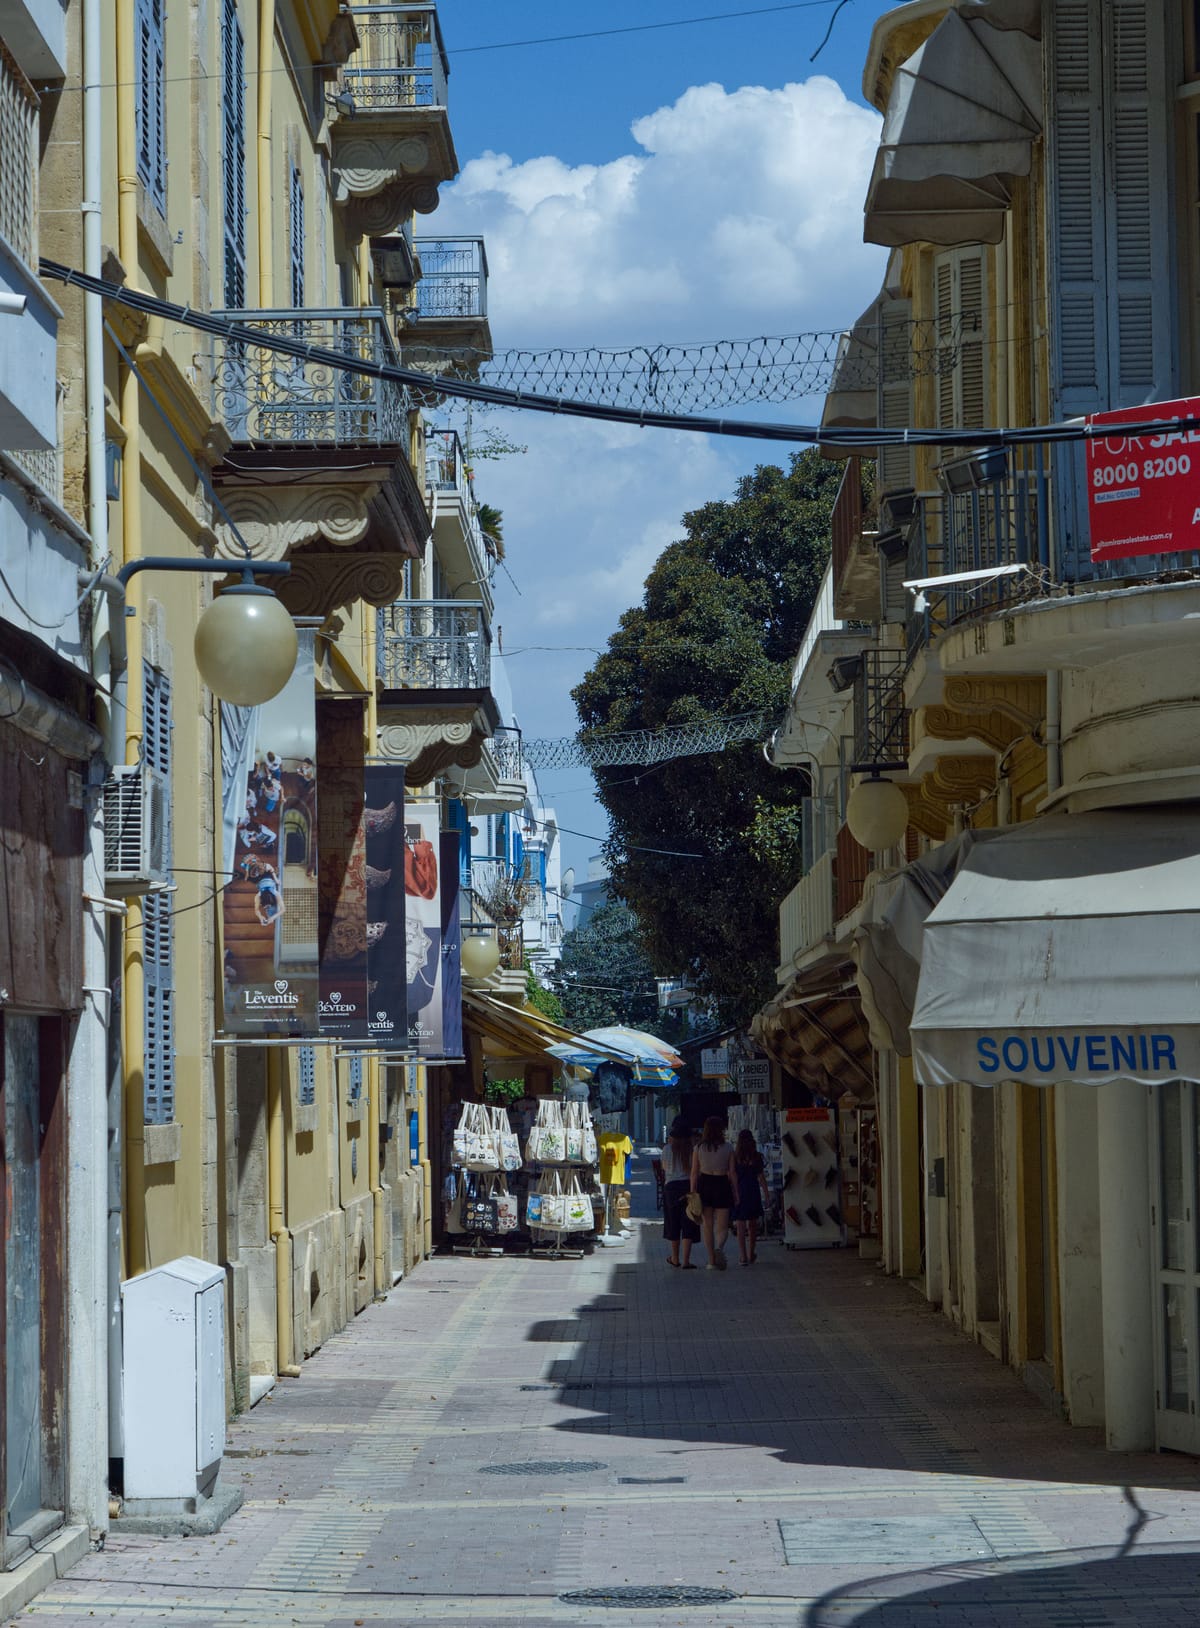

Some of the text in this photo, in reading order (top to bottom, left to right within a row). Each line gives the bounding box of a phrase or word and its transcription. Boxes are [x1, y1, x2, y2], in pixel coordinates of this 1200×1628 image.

[1093, 454, 1191, 488] 8000 8200
[244, 990, 299, 1004] Leventis
[976, 1034, 1177, 1073] SOUVENIR
